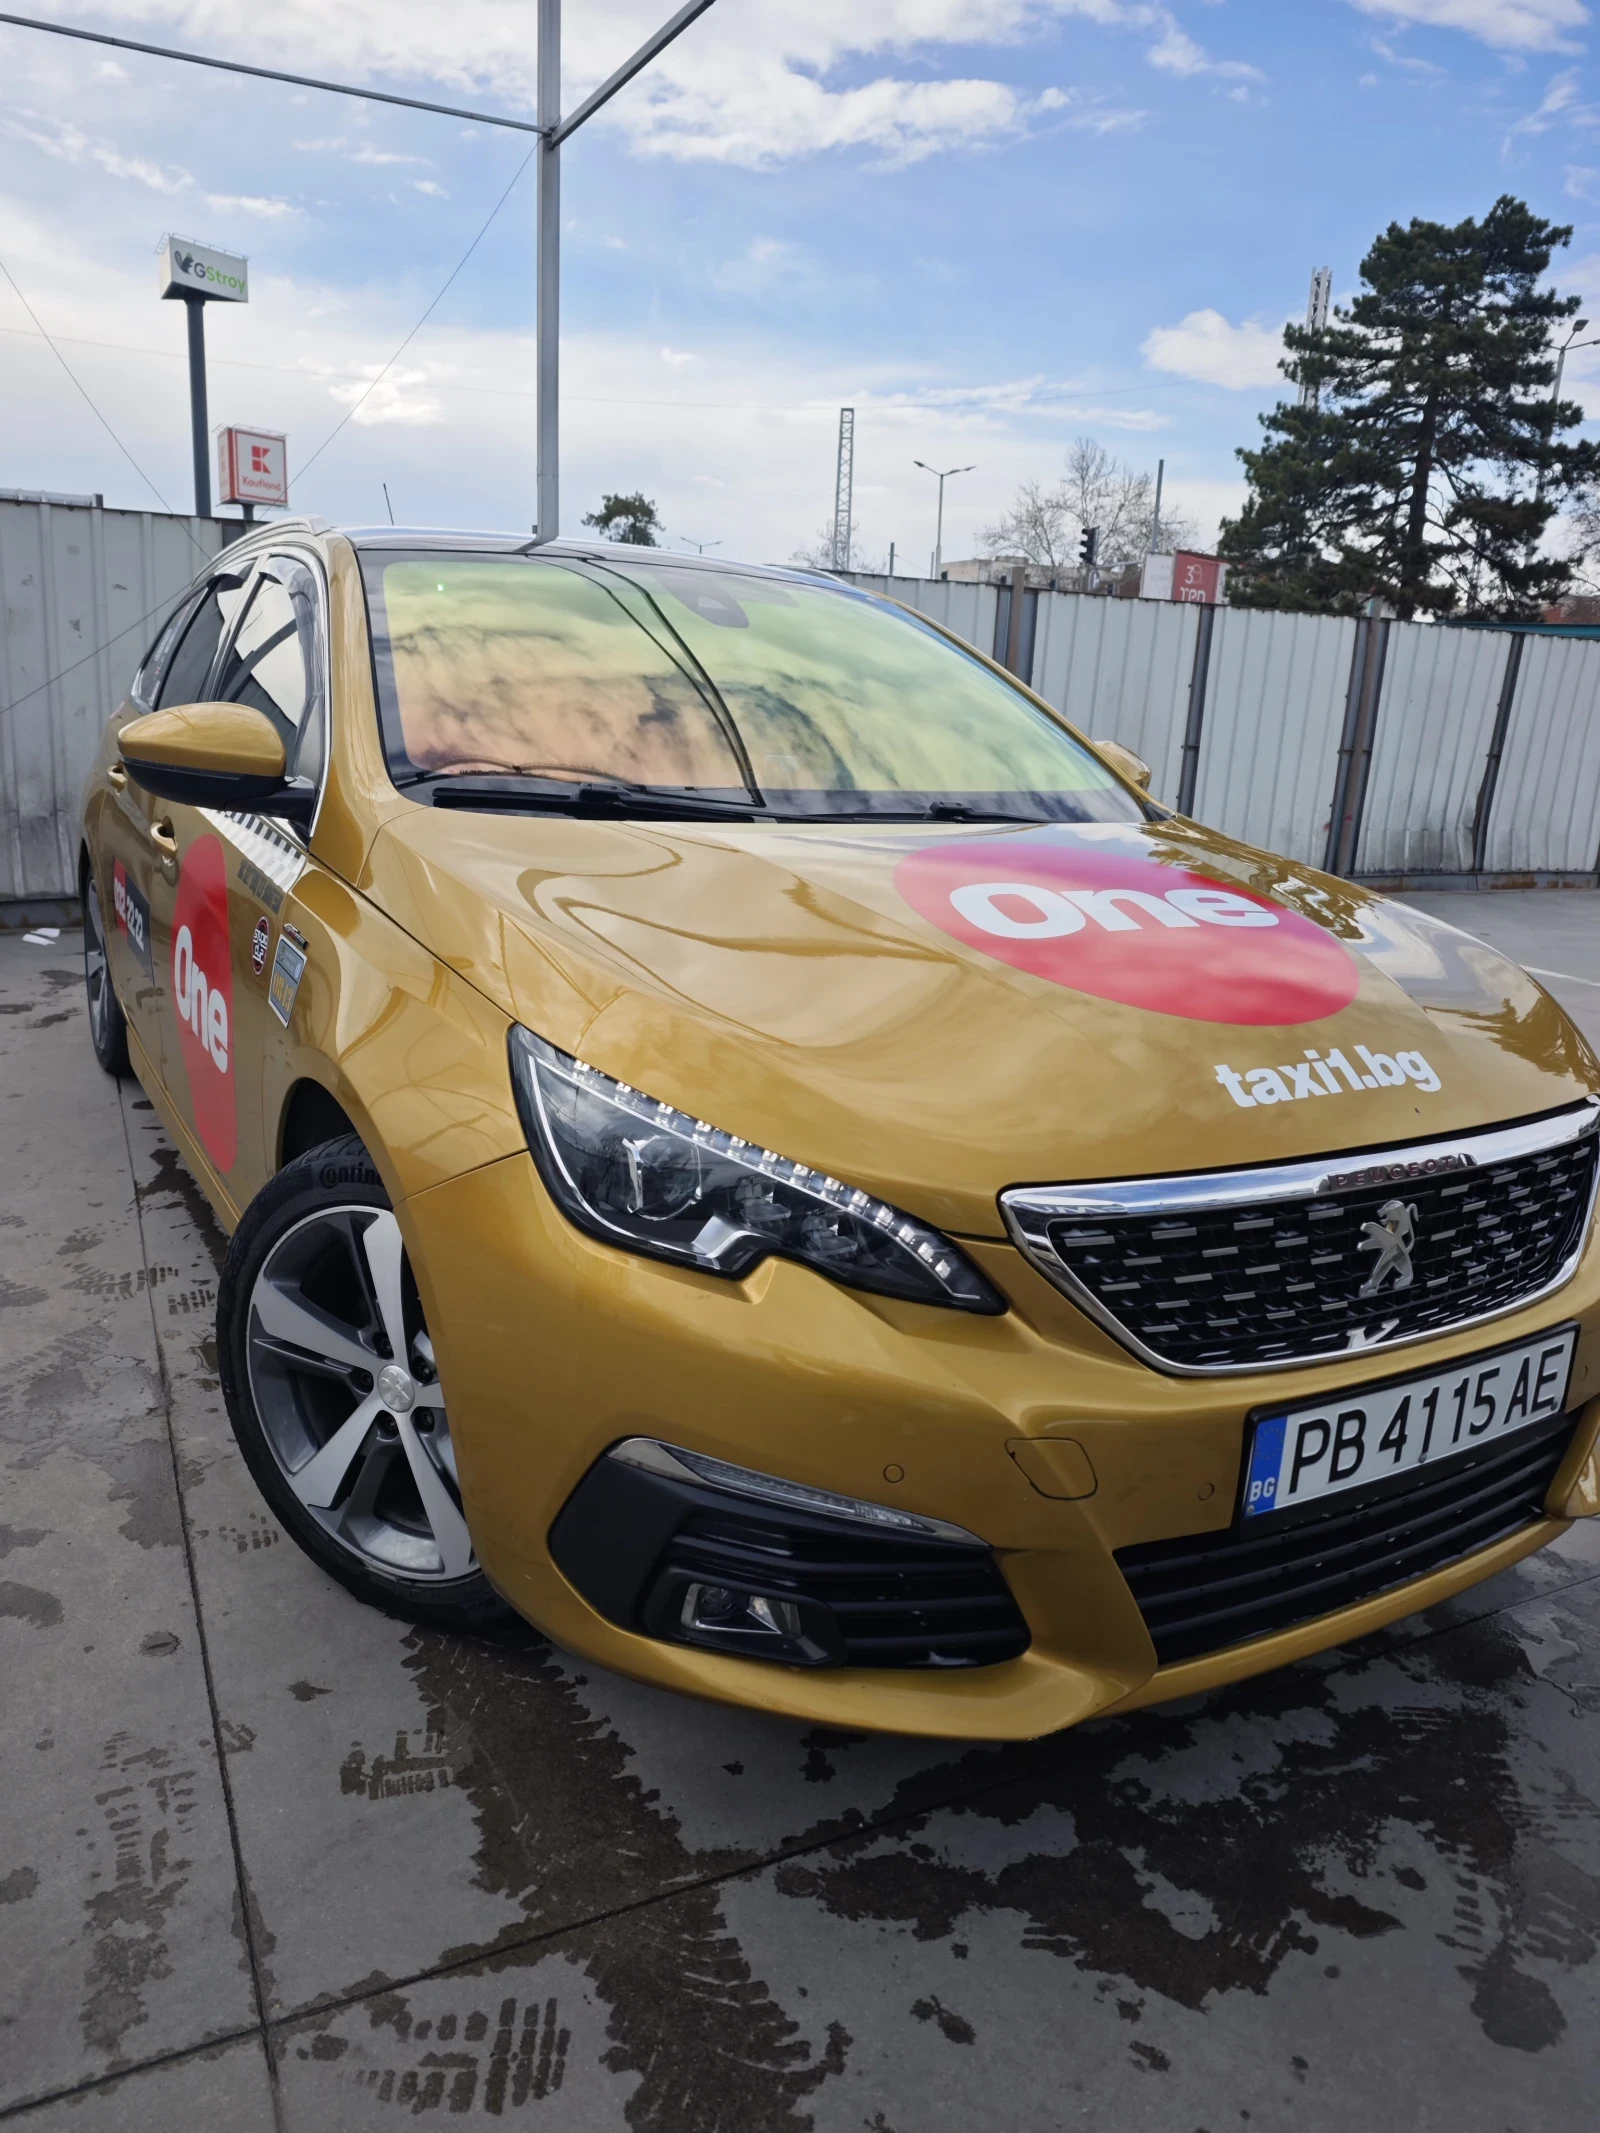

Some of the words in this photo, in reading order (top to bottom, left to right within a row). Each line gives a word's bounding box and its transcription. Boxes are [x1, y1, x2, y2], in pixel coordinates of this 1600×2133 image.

[193, 262, 246, 295] GStroy
[242, 476, 282, 492] Kaufland
[950, 881, 1280, 940] One
[174, 924, 229, 1074] One
[1213, 1044, 1442, 1108] taxi1.bg
[1336, 1154, 1454, 1188] PEUGEOT
[1288, 1408, 1368, 1495] PB
[1377, 1366, 1502, 1465] 4115
[1502, 1343, 1565, 1425] AE
[1250, 1476, 1276, 1501] BG
